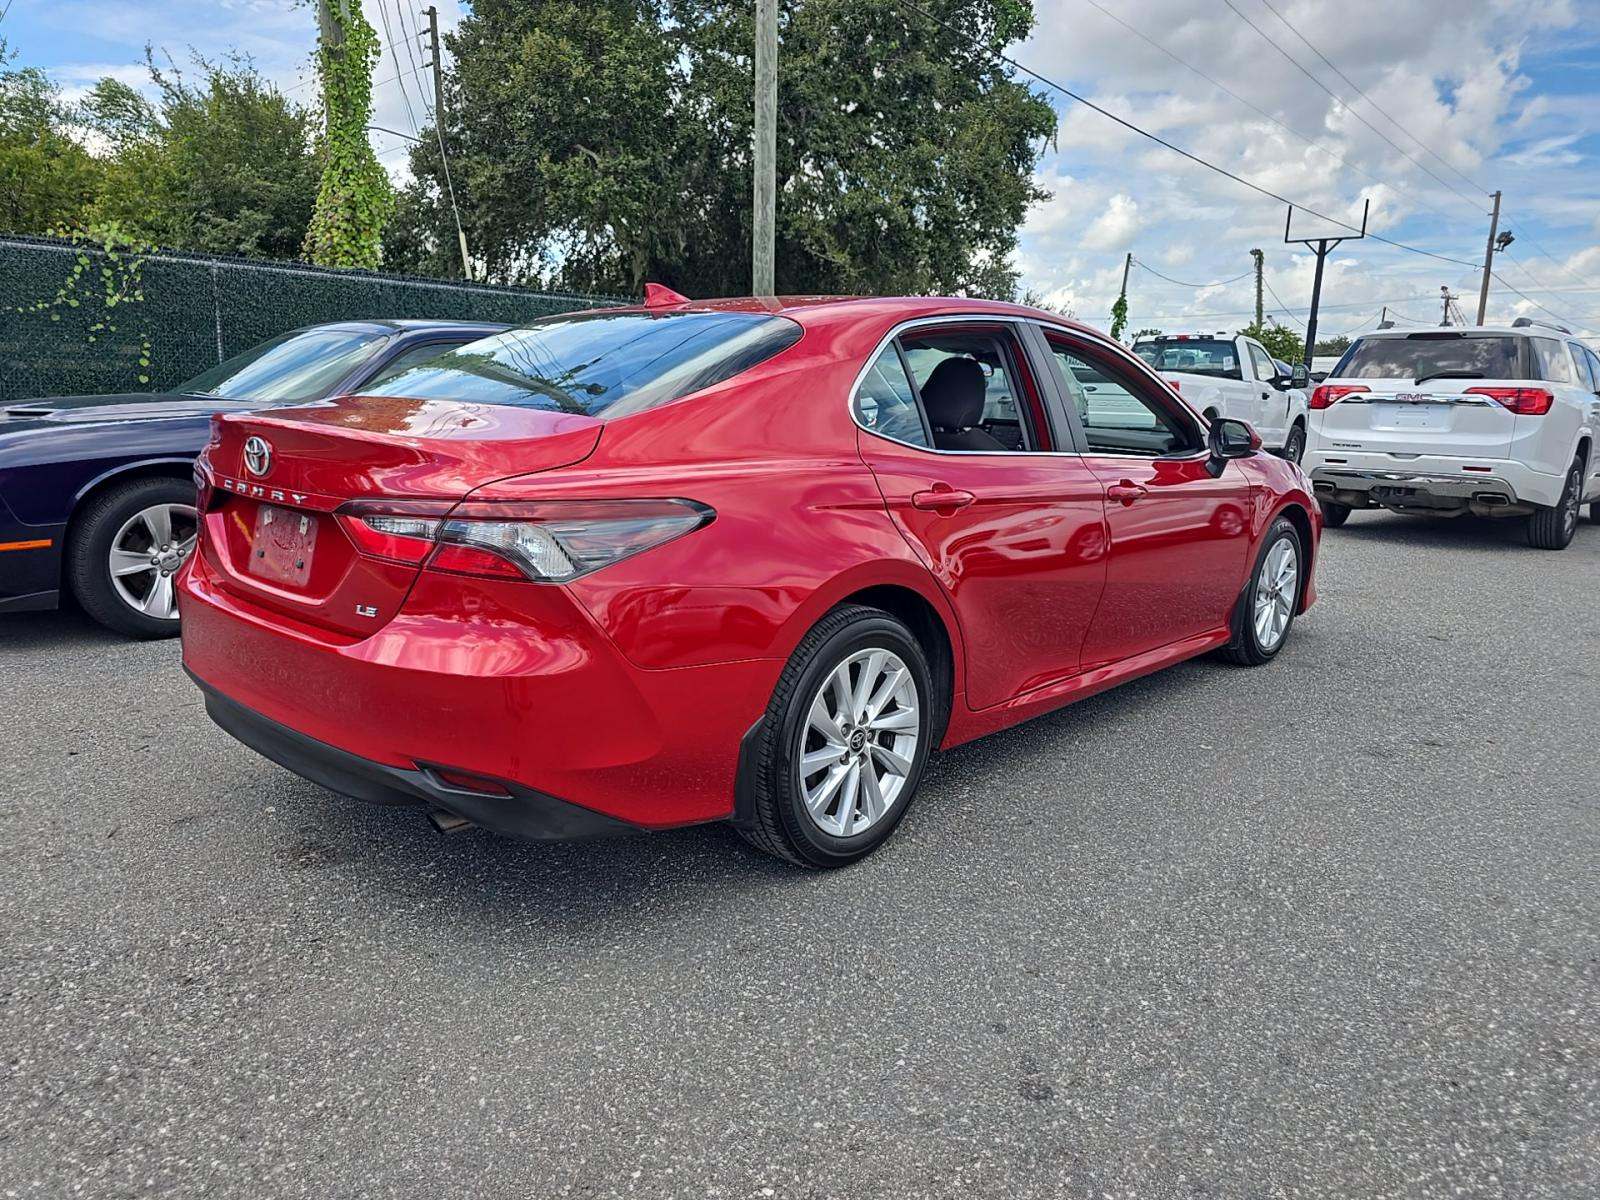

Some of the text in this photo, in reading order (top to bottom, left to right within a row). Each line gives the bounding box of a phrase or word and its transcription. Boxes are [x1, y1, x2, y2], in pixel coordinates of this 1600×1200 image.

[1395, 393, 1433, 401] GMC
[223, 479, 308, 503] CAMRY
[355, 604, 378, 618] LE
